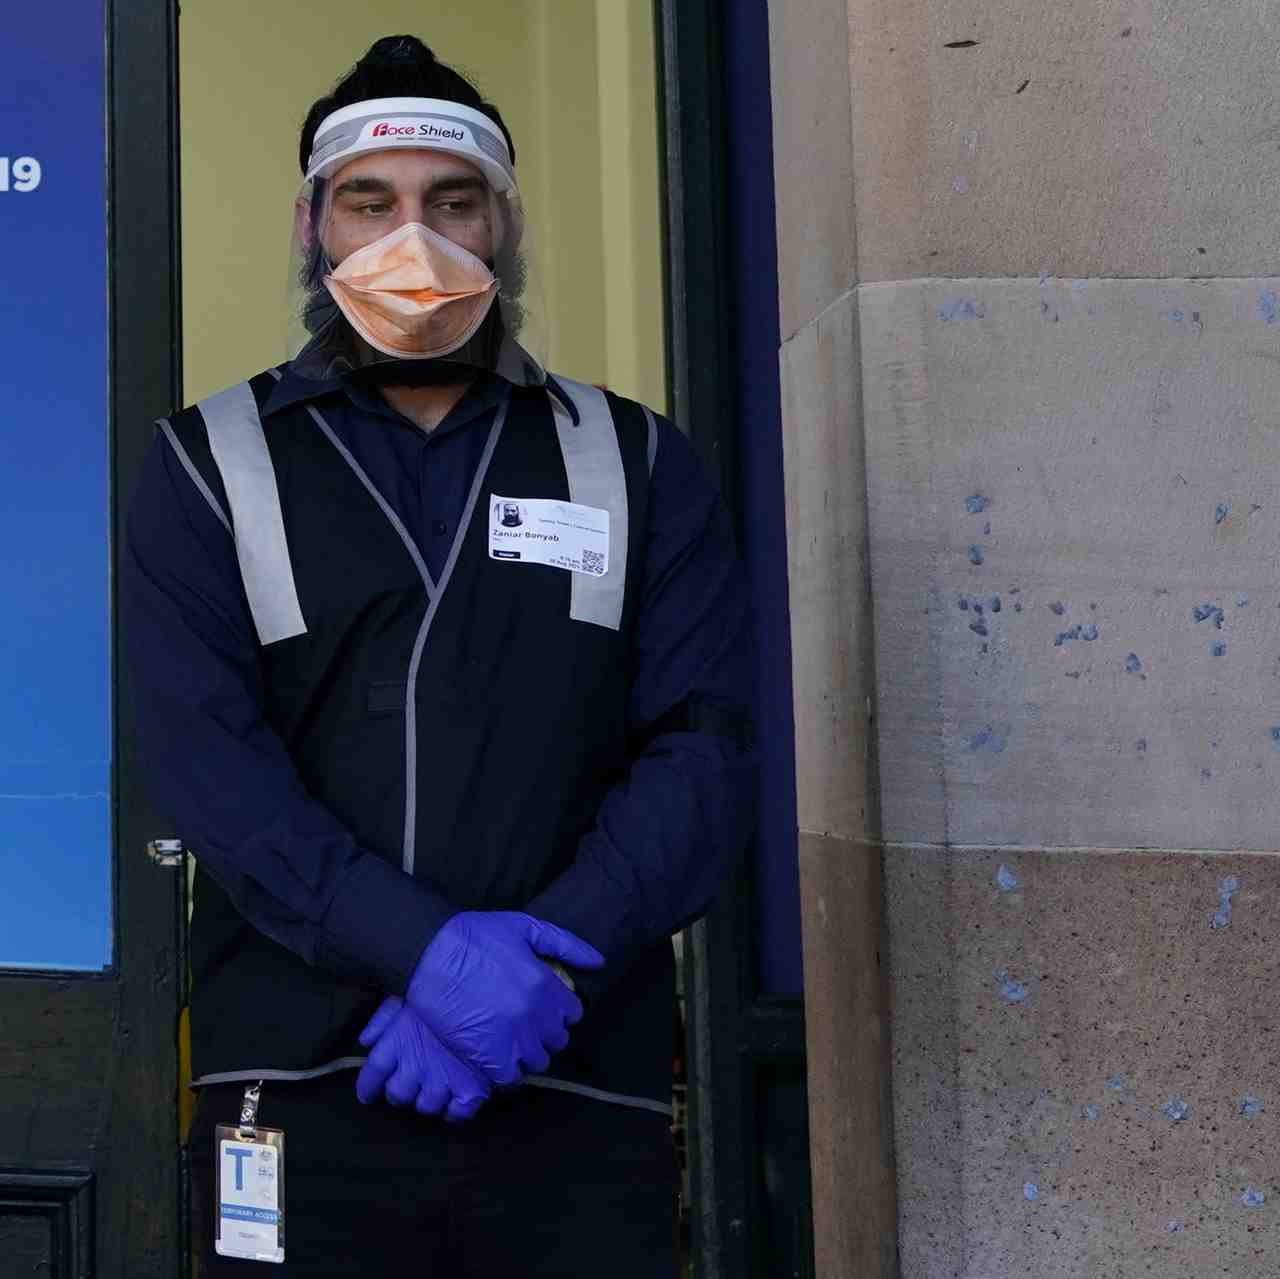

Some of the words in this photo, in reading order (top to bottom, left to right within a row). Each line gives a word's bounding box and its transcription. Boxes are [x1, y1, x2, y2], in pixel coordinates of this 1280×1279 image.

[372, 122, 416, 136] Face
[418, 124, 464, 140] Shield
[225, 1148, 253, 1191] T
